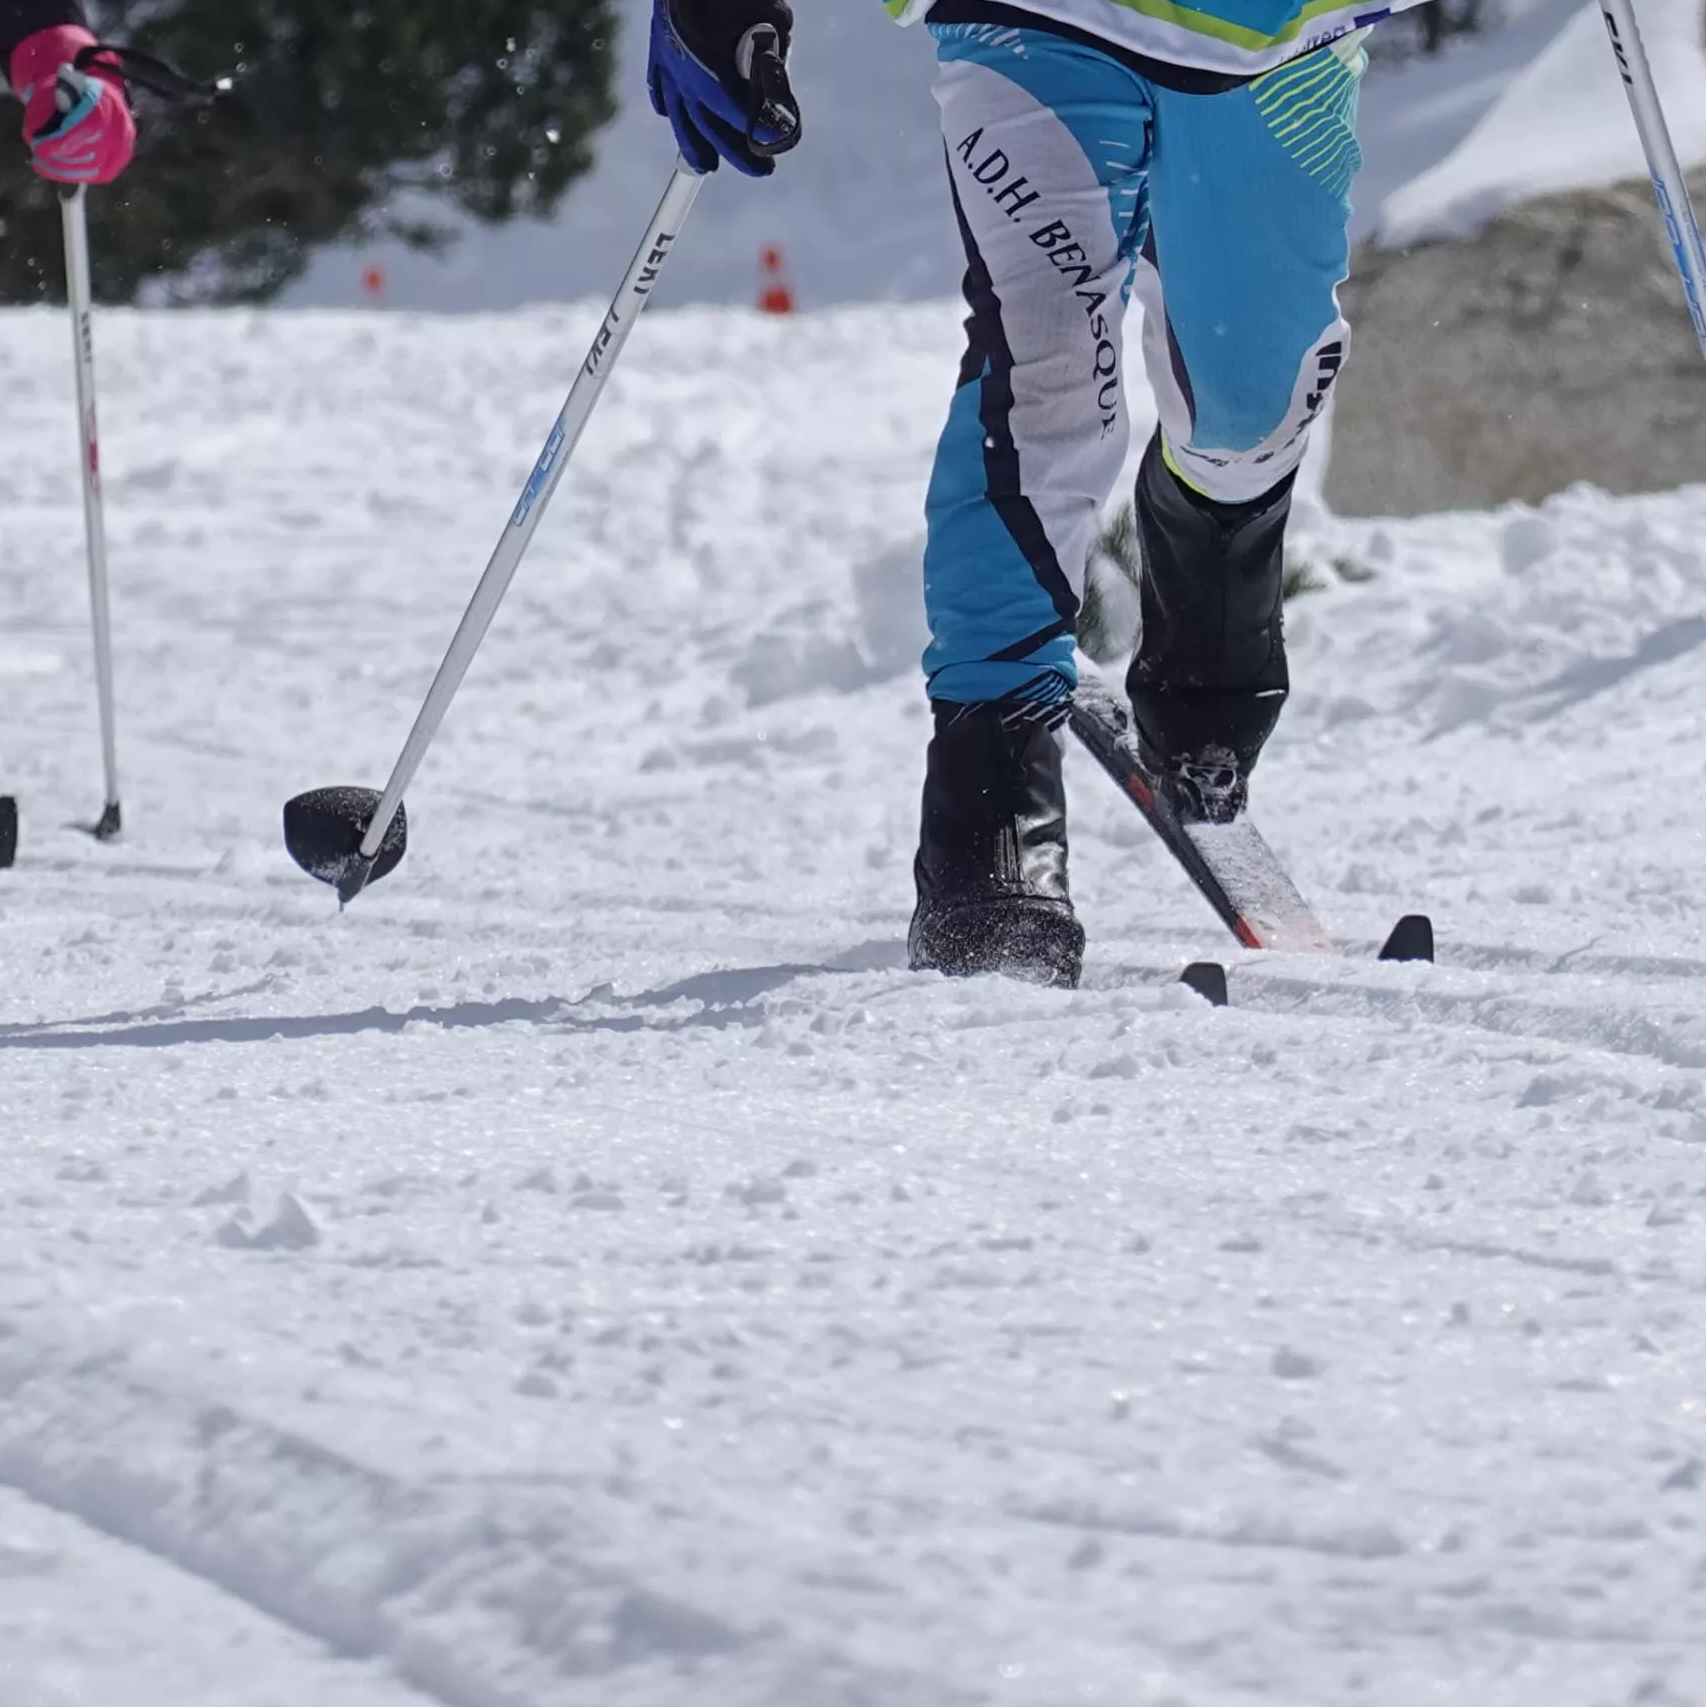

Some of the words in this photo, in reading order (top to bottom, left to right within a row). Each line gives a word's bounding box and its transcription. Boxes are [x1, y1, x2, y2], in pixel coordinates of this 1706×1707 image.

[633, 231, 675, 295] LEKI
[956, 126, 1042, 224] A.D.H.
[1027, 218, 1119, 441] BENASQUE
